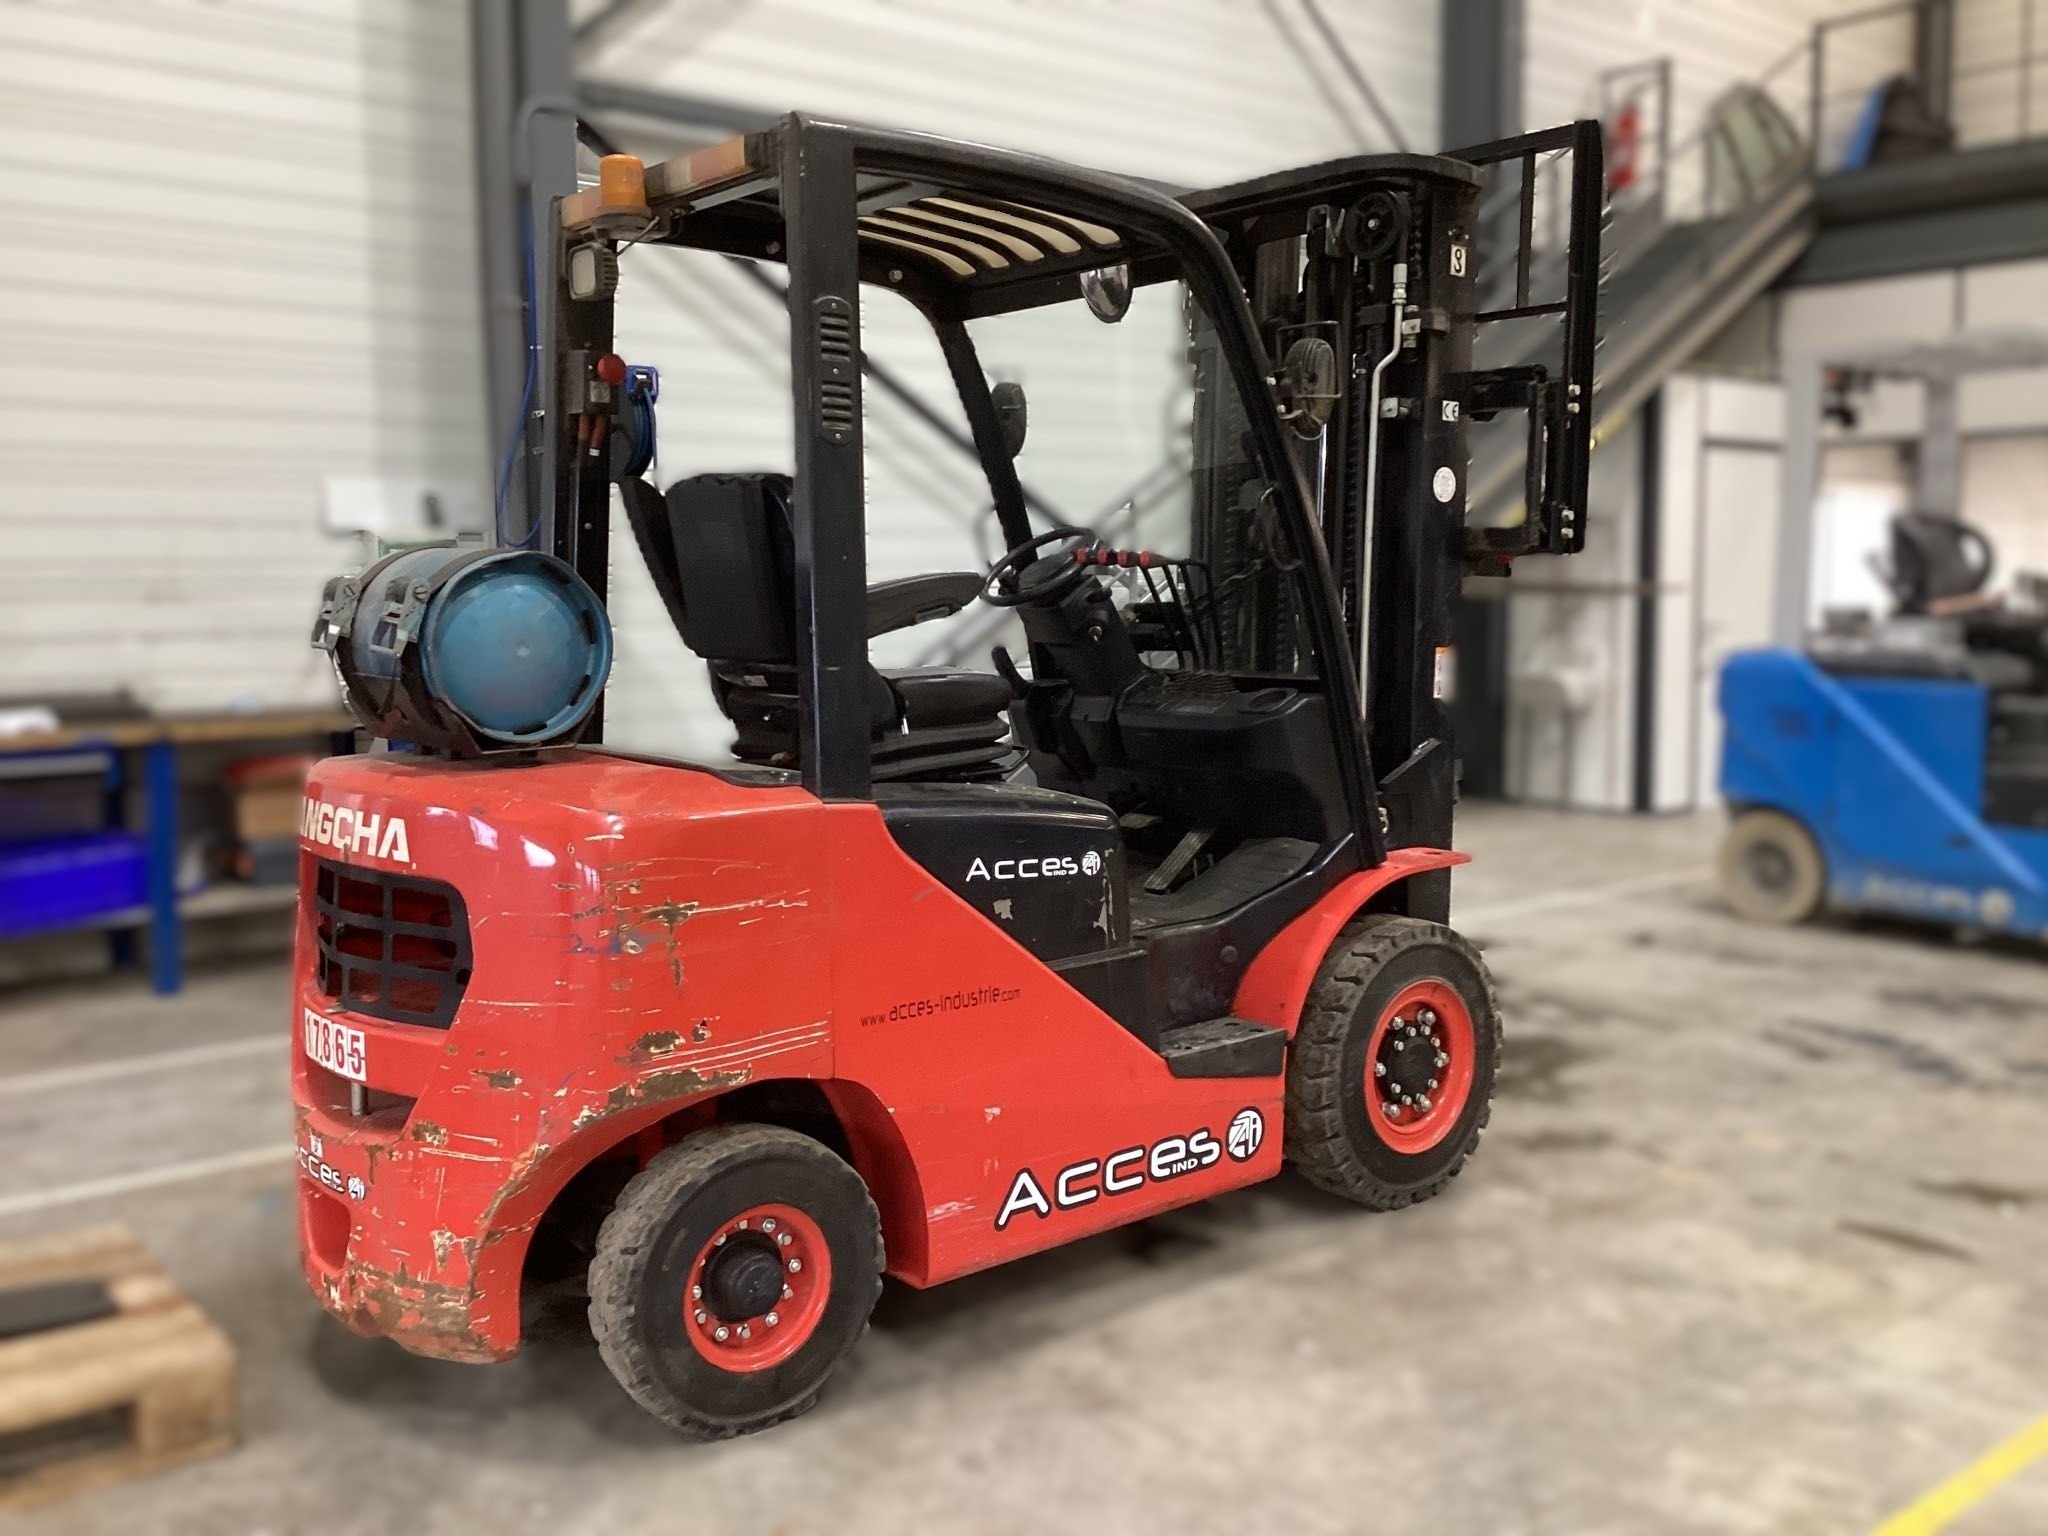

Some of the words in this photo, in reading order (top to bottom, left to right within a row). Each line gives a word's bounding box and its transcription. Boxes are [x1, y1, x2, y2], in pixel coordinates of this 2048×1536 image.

[965, 856, 1079, 882] Acces
[306, 1014, 363, 1075] 17865
[995, 1128, 1222, 1230] Acces
[1172, 1157, 1199, 1175] IND
